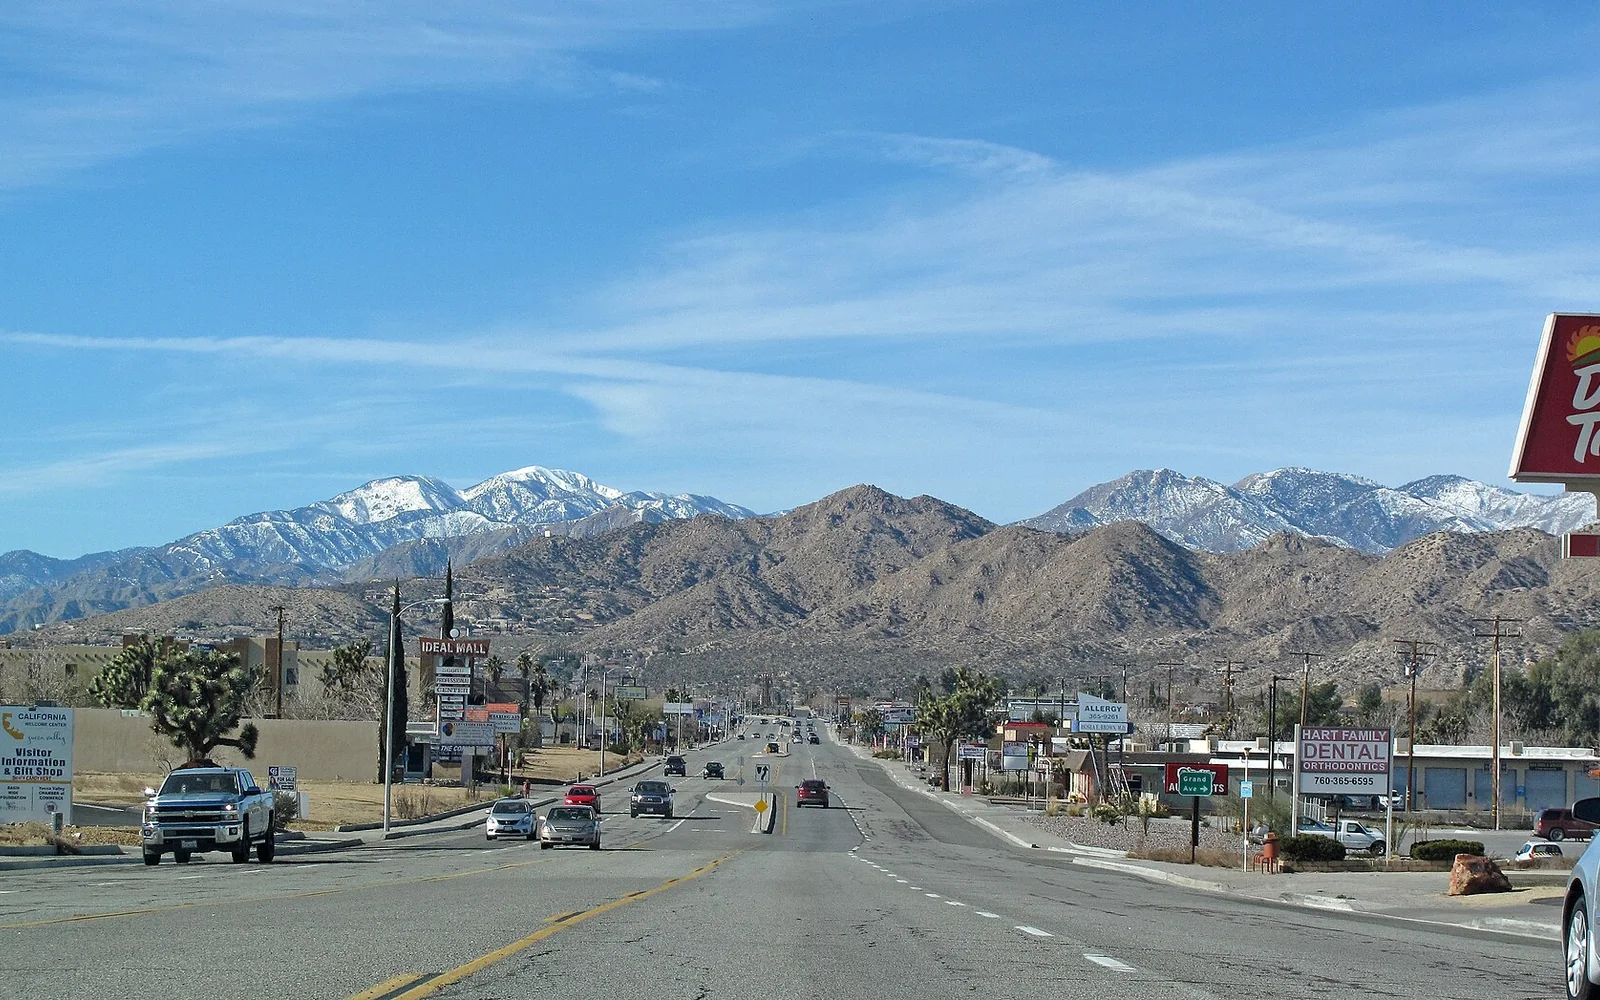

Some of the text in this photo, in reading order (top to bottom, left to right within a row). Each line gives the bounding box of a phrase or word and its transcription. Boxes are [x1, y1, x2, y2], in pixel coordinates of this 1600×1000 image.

[422, 642, 486, 654] IDEAL MALL
[1303, 729, 1387, 741] HART FAMILY
[16, 748, 52, 757] Visitor
[1304, 743, 1385, 760] DENTAL
[2, 757, 66, 767] Information
[1303, 762, 1386, 771] ORTHODONTICS
[4, 767, 63, 776] & Gift Shop
[1314, 777, 1374, 786] 760-365-6595
